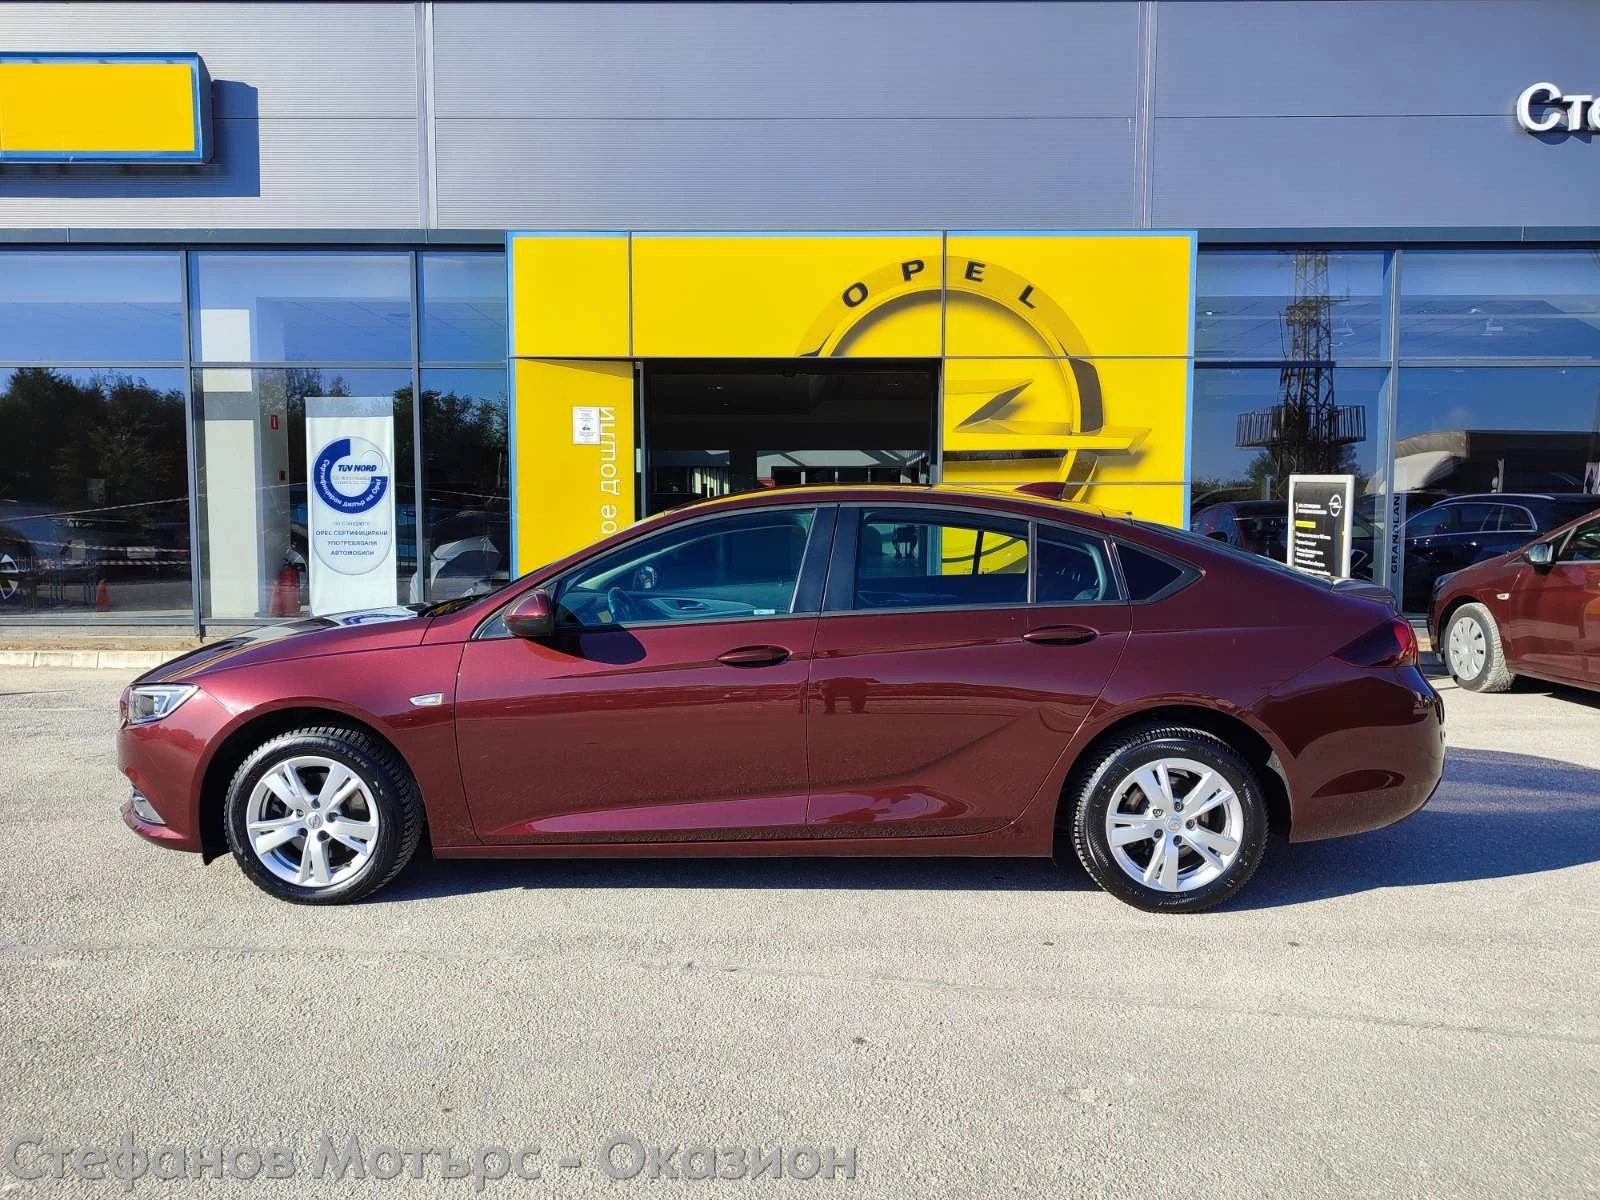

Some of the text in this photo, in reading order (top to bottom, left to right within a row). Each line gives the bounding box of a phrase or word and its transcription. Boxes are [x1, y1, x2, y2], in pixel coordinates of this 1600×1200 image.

[841, 259, 1037, 310] OPEL
[600, 406, 621, 496] дошли
[354, 464, 377, 472] NORD
[371, 478, 382, 494] Opel
